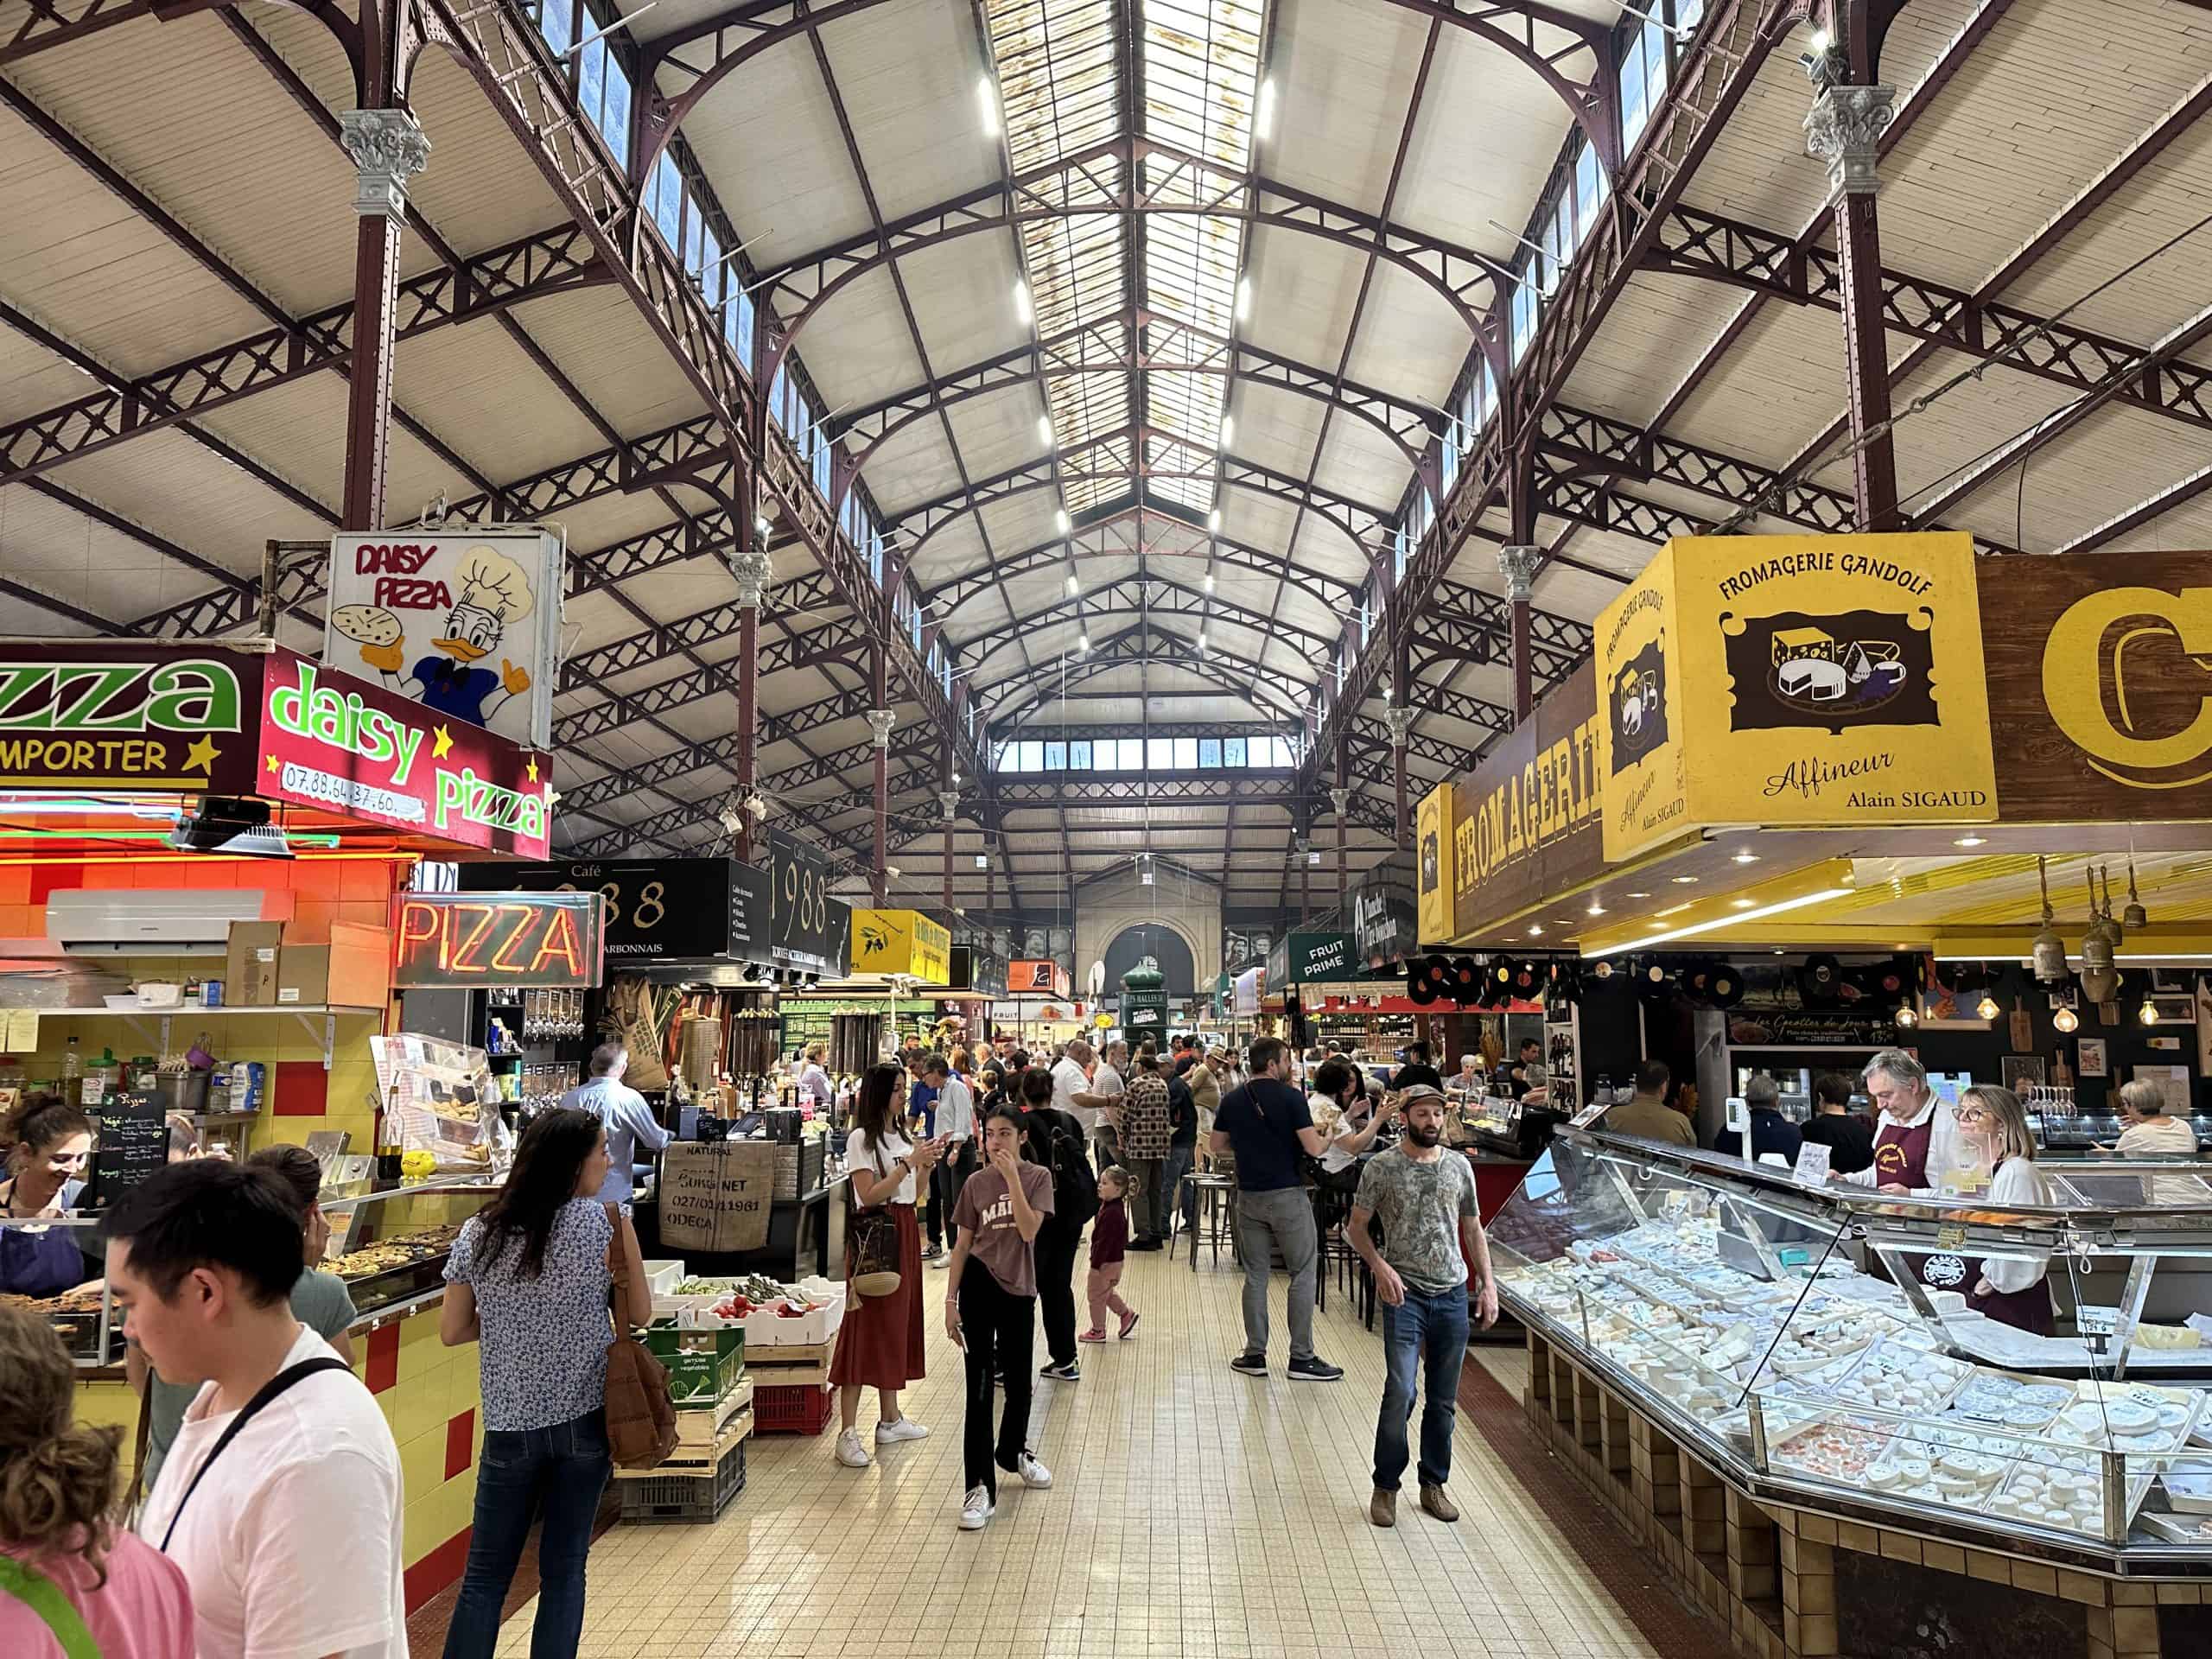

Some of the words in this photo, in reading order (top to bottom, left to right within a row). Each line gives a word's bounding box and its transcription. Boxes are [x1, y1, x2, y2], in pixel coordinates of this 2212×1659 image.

[356, 544, 437, 575] DAISY
[1719, 552, 1834, 600] FROMAGERIE
[1841, 554, 1932, 596] GANDOLF
[374, 576, 453, 610] PIZZA
[1606, 594, 1637, 663] FROMAGERIE
[1638, 588, 1664, 613] GANDOLF
[270, 659, 424, 785] daisy
[1763, 752, 1895, 799] Affineur
[434, 767, 545, 841] pizza
[1619, 770, 1657, 831] Affineur
[1657, 797, 1684, 824] SIGAUD
[1846, 792, 1895, 808] Alain
[1902, 790, 1986, 808] SIGAUD
[571, 865, 601, 877] Café
[771, 854, 826, 941] 1988
[396, 902, 584, 976] PIZZA
[1309, 939, 1344, 961] FRUIT
[1304, 955, 1344, 976] PRIME
[687, 1146, 734, 1156] NATURAL
[722, 1179, 747, 1192] NET
[667, 1212, 712, 1230] ODECA
